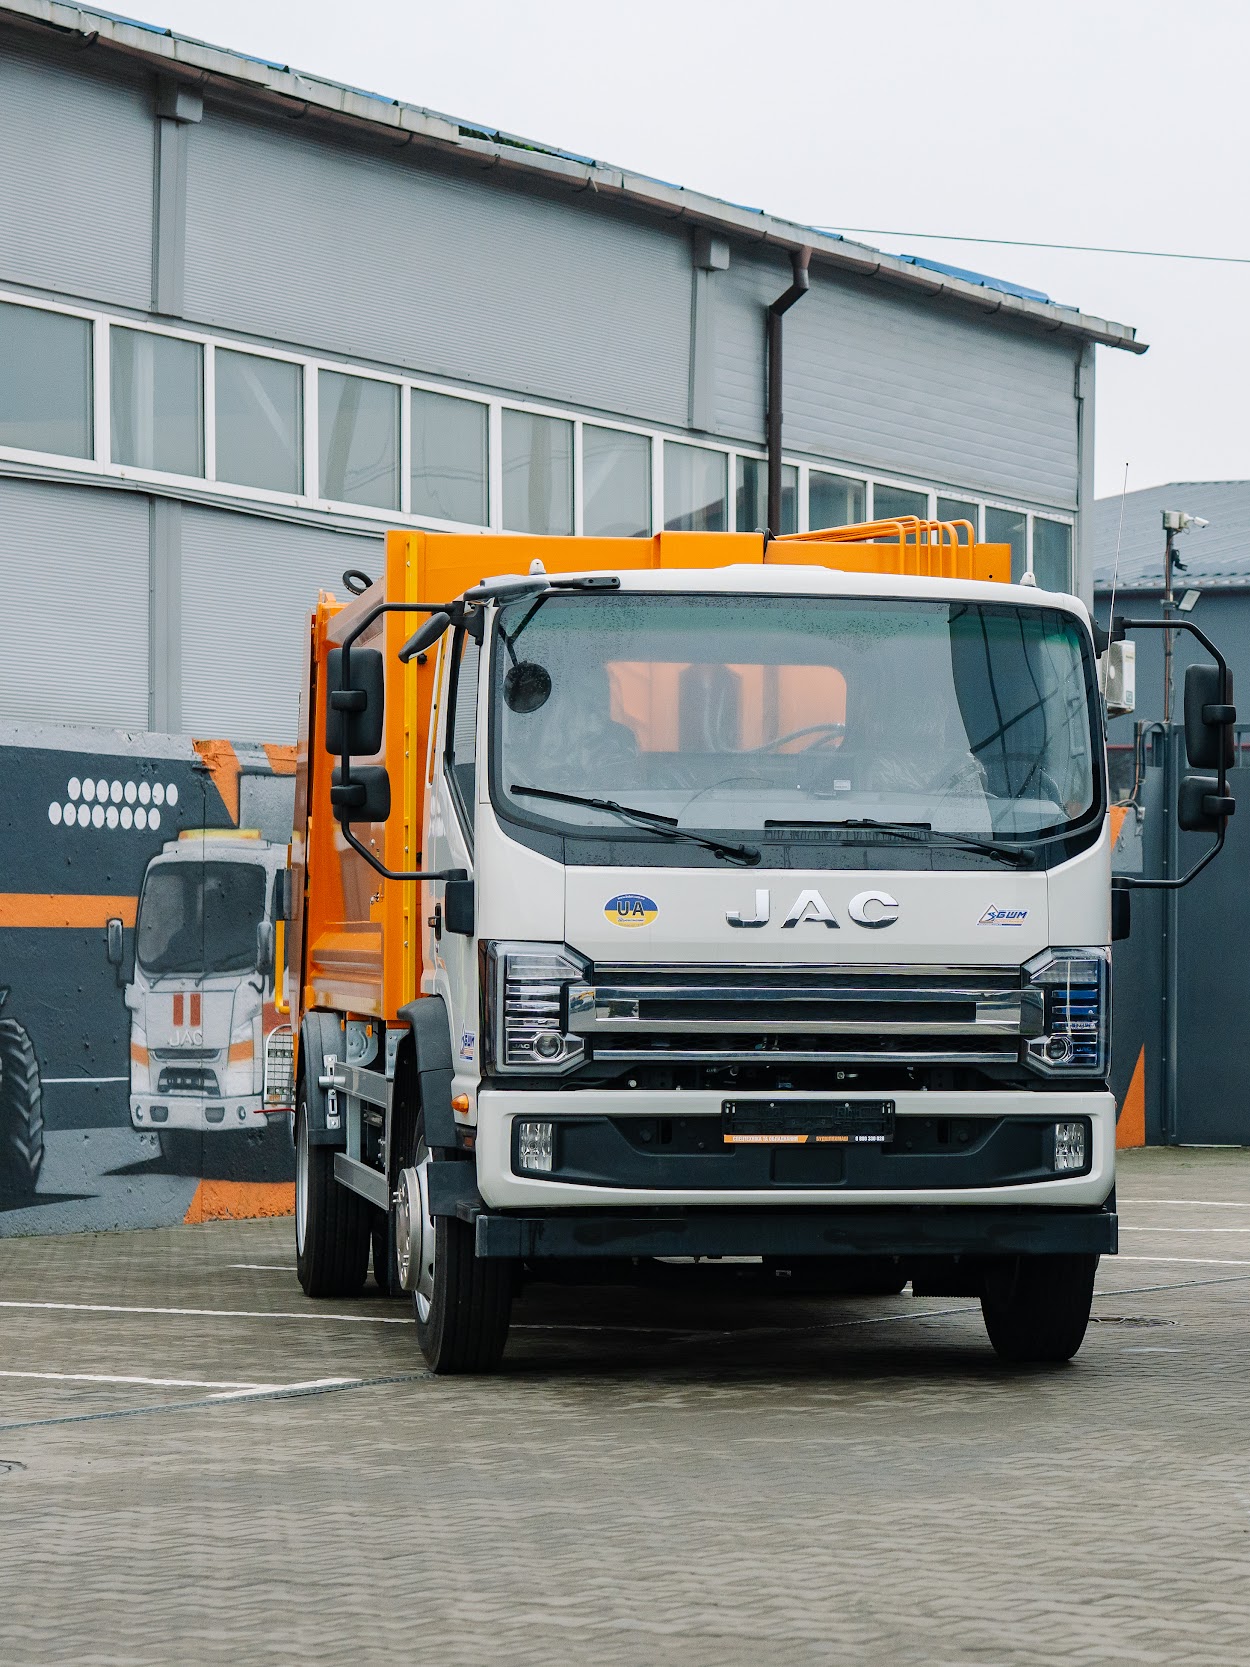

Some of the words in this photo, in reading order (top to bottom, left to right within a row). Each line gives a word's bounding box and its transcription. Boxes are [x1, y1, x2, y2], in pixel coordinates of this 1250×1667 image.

[617, 901, 645, 916] UA
[725, 889, 899, 929] JAC
[168, 1030, 203, 1047] JAC
